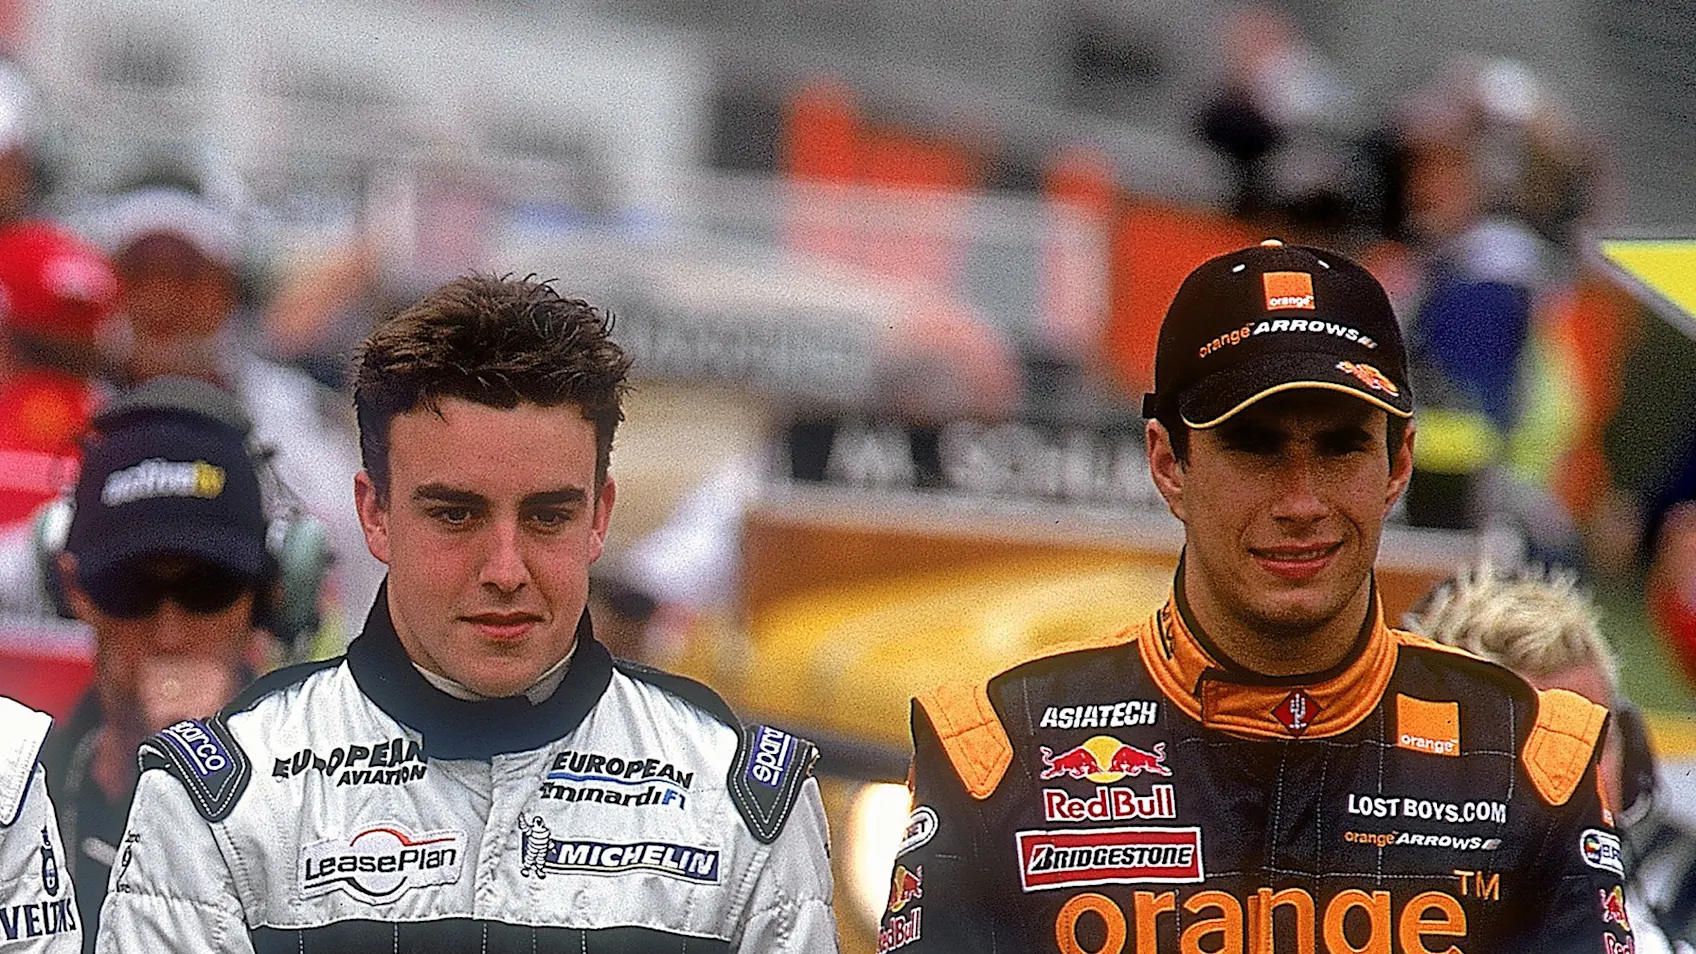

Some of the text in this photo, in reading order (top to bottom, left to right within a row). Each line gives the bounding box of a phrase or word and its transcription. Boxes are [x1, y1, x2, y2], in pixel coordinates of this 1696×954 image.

[1268, 295, 1310, 309] orange
[1198, 325, 1251, 358] orange
[1040, 701, 1158, 729] ASIATECH
[1400, 734, 1455, 754] orange
[337, 766, 428, 788] AVIATION
[553, 750, 695, 790] EUROPEAN
[1045, 786, 1174, 820] Red Bull
[1347, 793, 1507, 824] LOST BOYS.COM
[1344, 830, 1396, 847] orange
[305, 848, 457, 880] LeasePlan
[557, 842, 716, 875] MICHELIN
[1030, 846, 1193, 872] BRIDGESTONE
[895, 907, 921, 946] Bull
